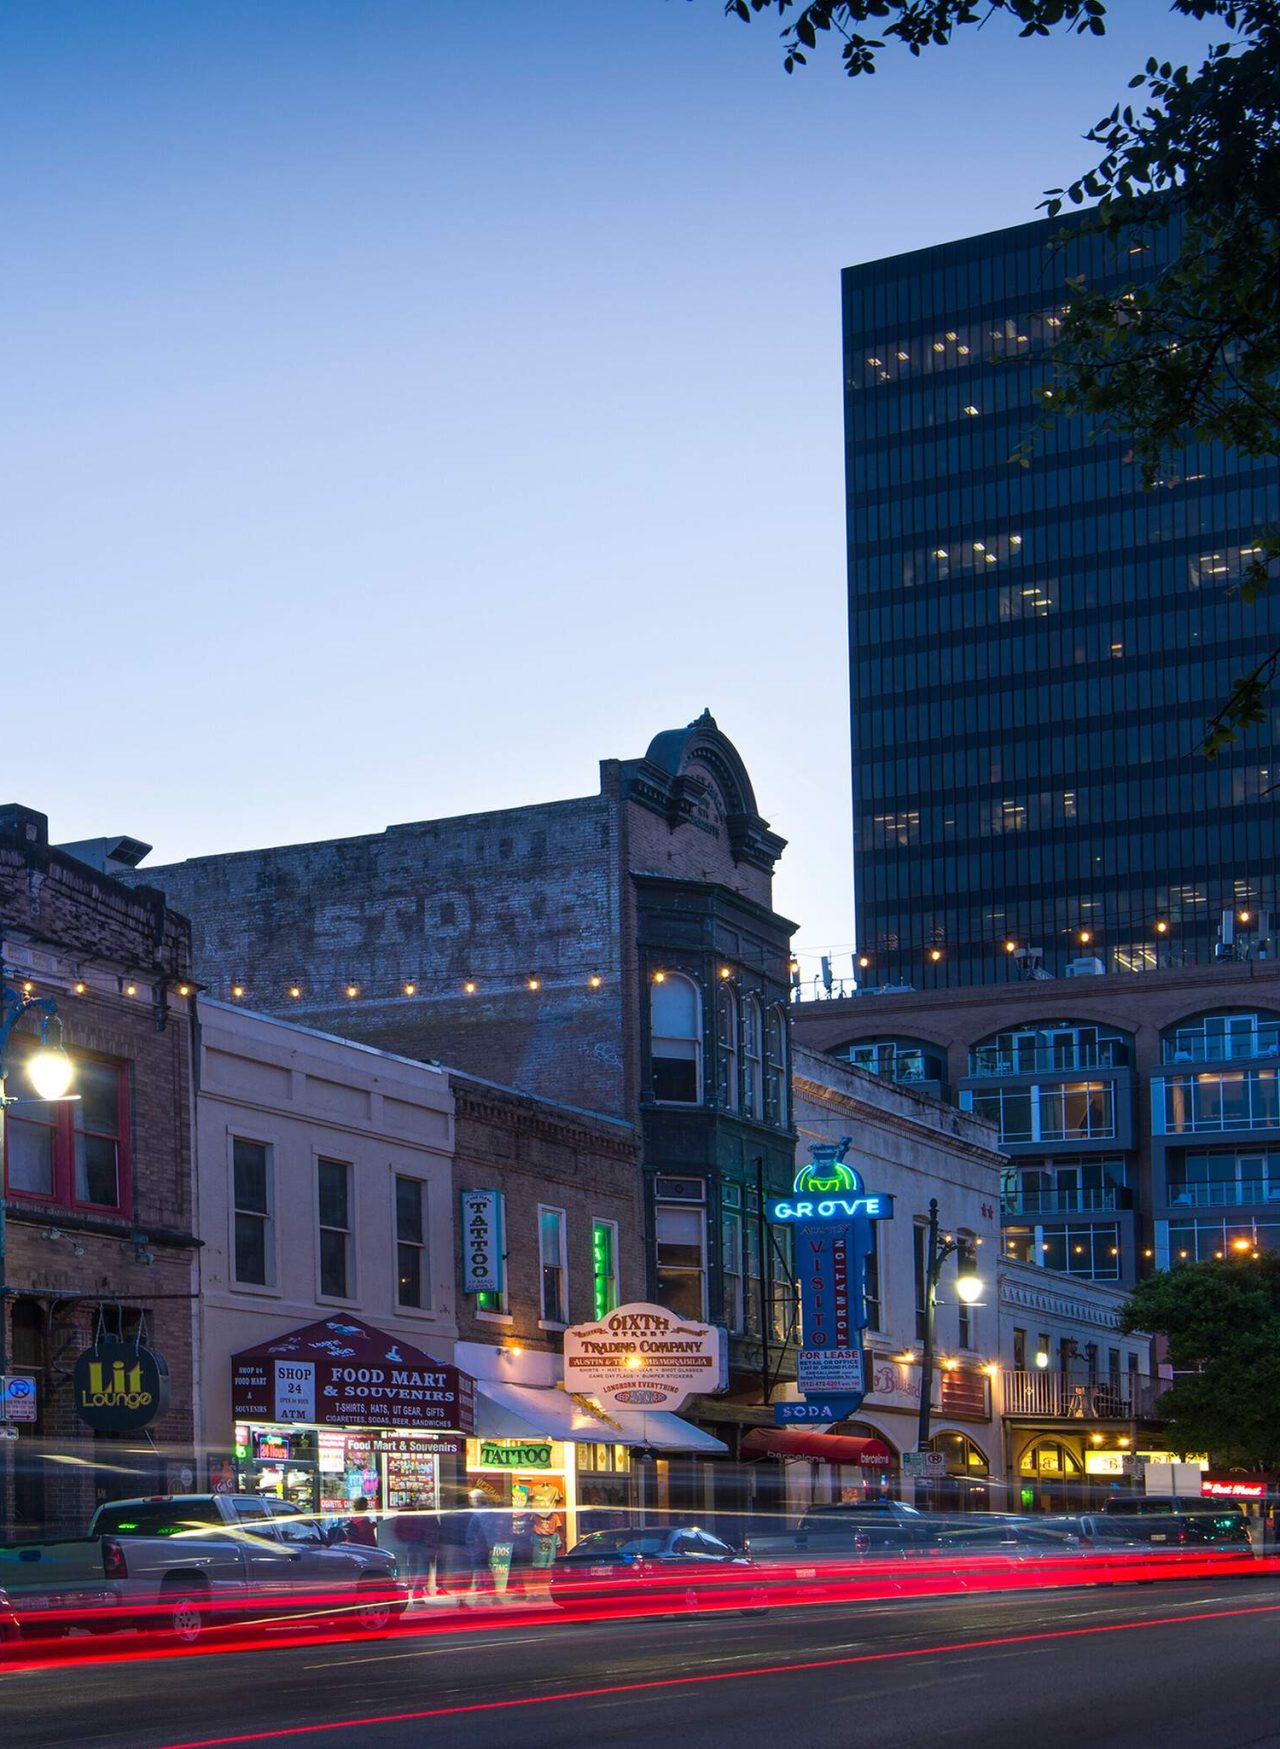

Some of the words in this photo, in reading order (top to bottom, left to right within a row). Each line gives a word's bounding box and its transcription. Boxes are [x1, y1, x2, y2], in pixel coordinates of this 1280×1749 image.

[774, 1199, 880, 1218] GROVE
[470, 1202, 488, 1278] TATTOO
[640, 1340, 703, 1355] COMPANY
[800, 1351, 820, 1359] FOR
[824, 1350, 858, 1359] LEASE
[573, 1358, 604, 1366] AUSTIN
[89, 1360, 144, 1394] Lit
[278, 1367, 311, 1380] SHOP
[331, 1368, 385, 1383] FOOD
[392, 1370, 447, 1387] MART
[288, 1383, 303, 1394] 24
[603, 1381, 637, 1393] LONGHORN
[638, 1381, 680, 1394] EVERYTHING
[878, 1365, 922, 1399] Billiard
[82, 1389, 152, 1410] Lounge
[323, 1385, 338, 1397] &
[344, 1386, 455, 1402] SOUVENIRS
[281, 1409, 307, 1420] ATM
[335, 1402, 368, 1414] T-SHIRTS,
[370, 1403, 390, 1415] HATS,
[403, 1406, 423, 1417] GEAR,
[426, 1407, 445, 1418] GIFTS
[783, 1405, 833, 1417] SODA
[412, 1419, 452, 1428] SANDWICHES
[348, 1440, 371, 1450] Food
[373, 1440, 397, 1450] Mart
[399, 1441, 408, 1451] &
[409, 1442, 458, 1453] Souvenirs
[482, 1448, 550, 1465] TATTOO
